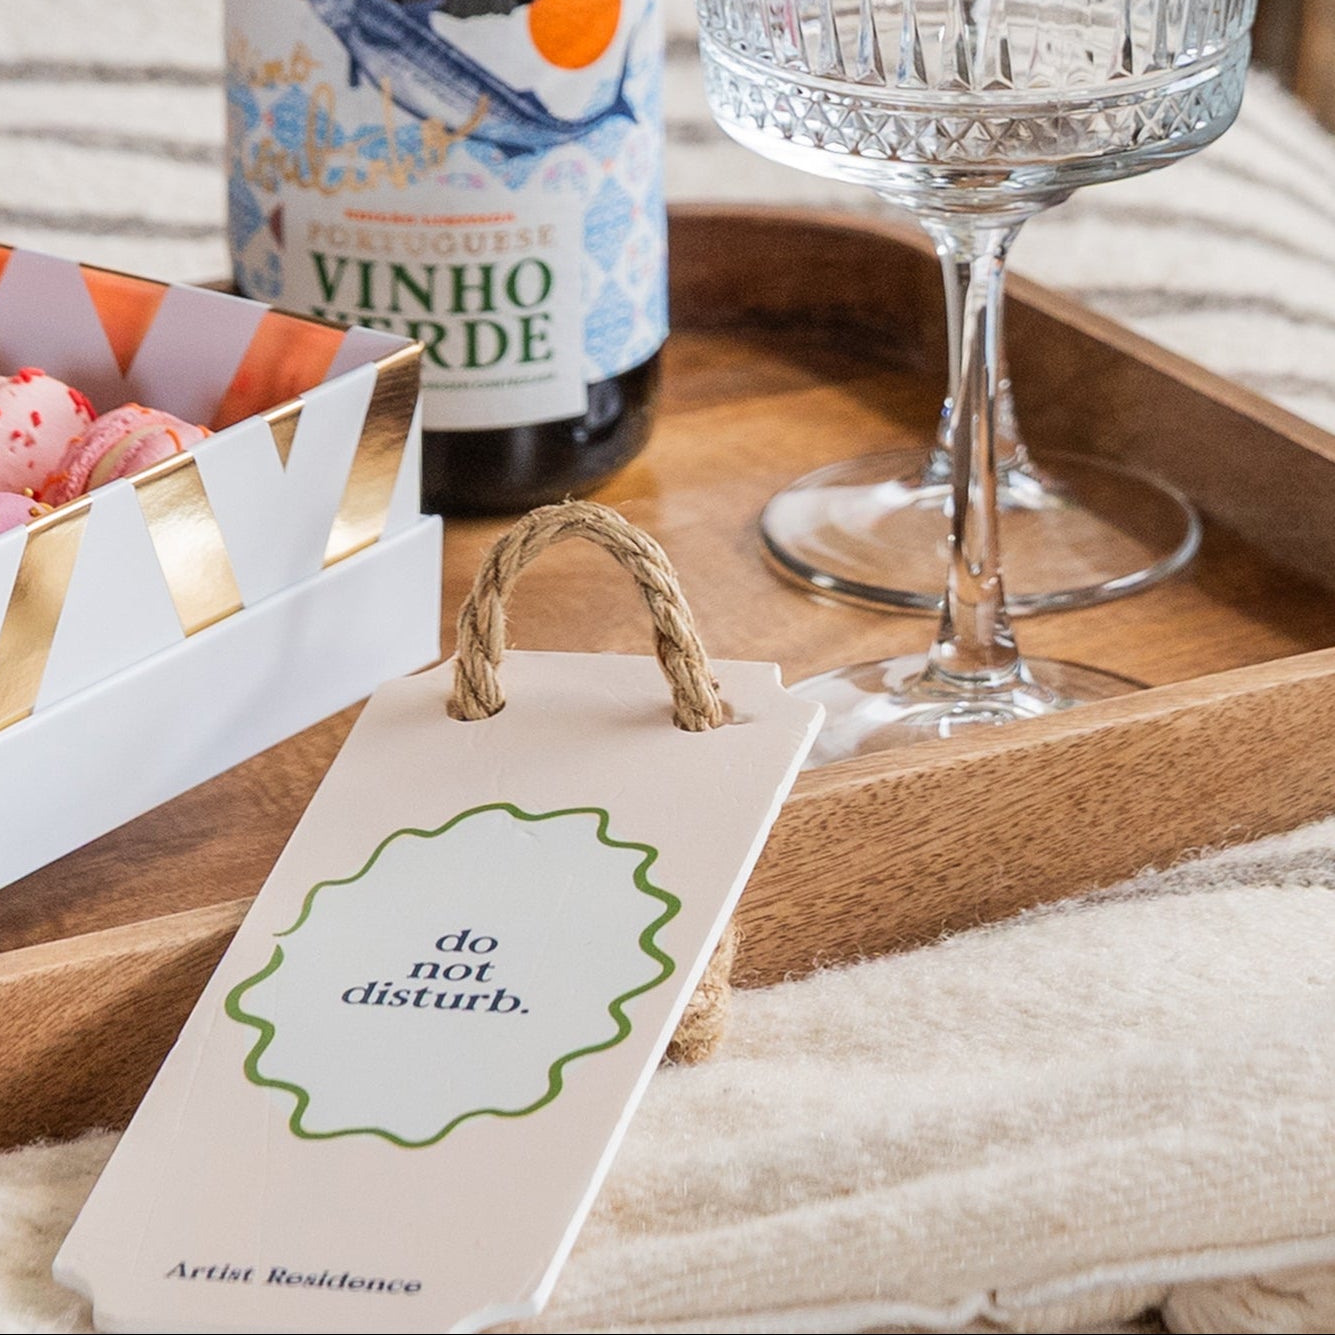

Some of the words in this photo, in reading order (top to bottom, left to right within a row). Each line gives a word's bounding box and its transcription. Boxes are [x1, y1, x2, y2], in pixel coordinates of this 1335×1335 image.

[307, 222, 555, 258] PORTUGUESE
[311, 250, 552, 314] VINHO
[311, 307, 553, 370] RDE
[434, 928, 498, 954] do
[406, 961, 495, 983] not
[341, 981, 529, 1014] disturb.
[166, 1260, 254, 1283] Artist
[265, 1267, 422, 1295] Residence
